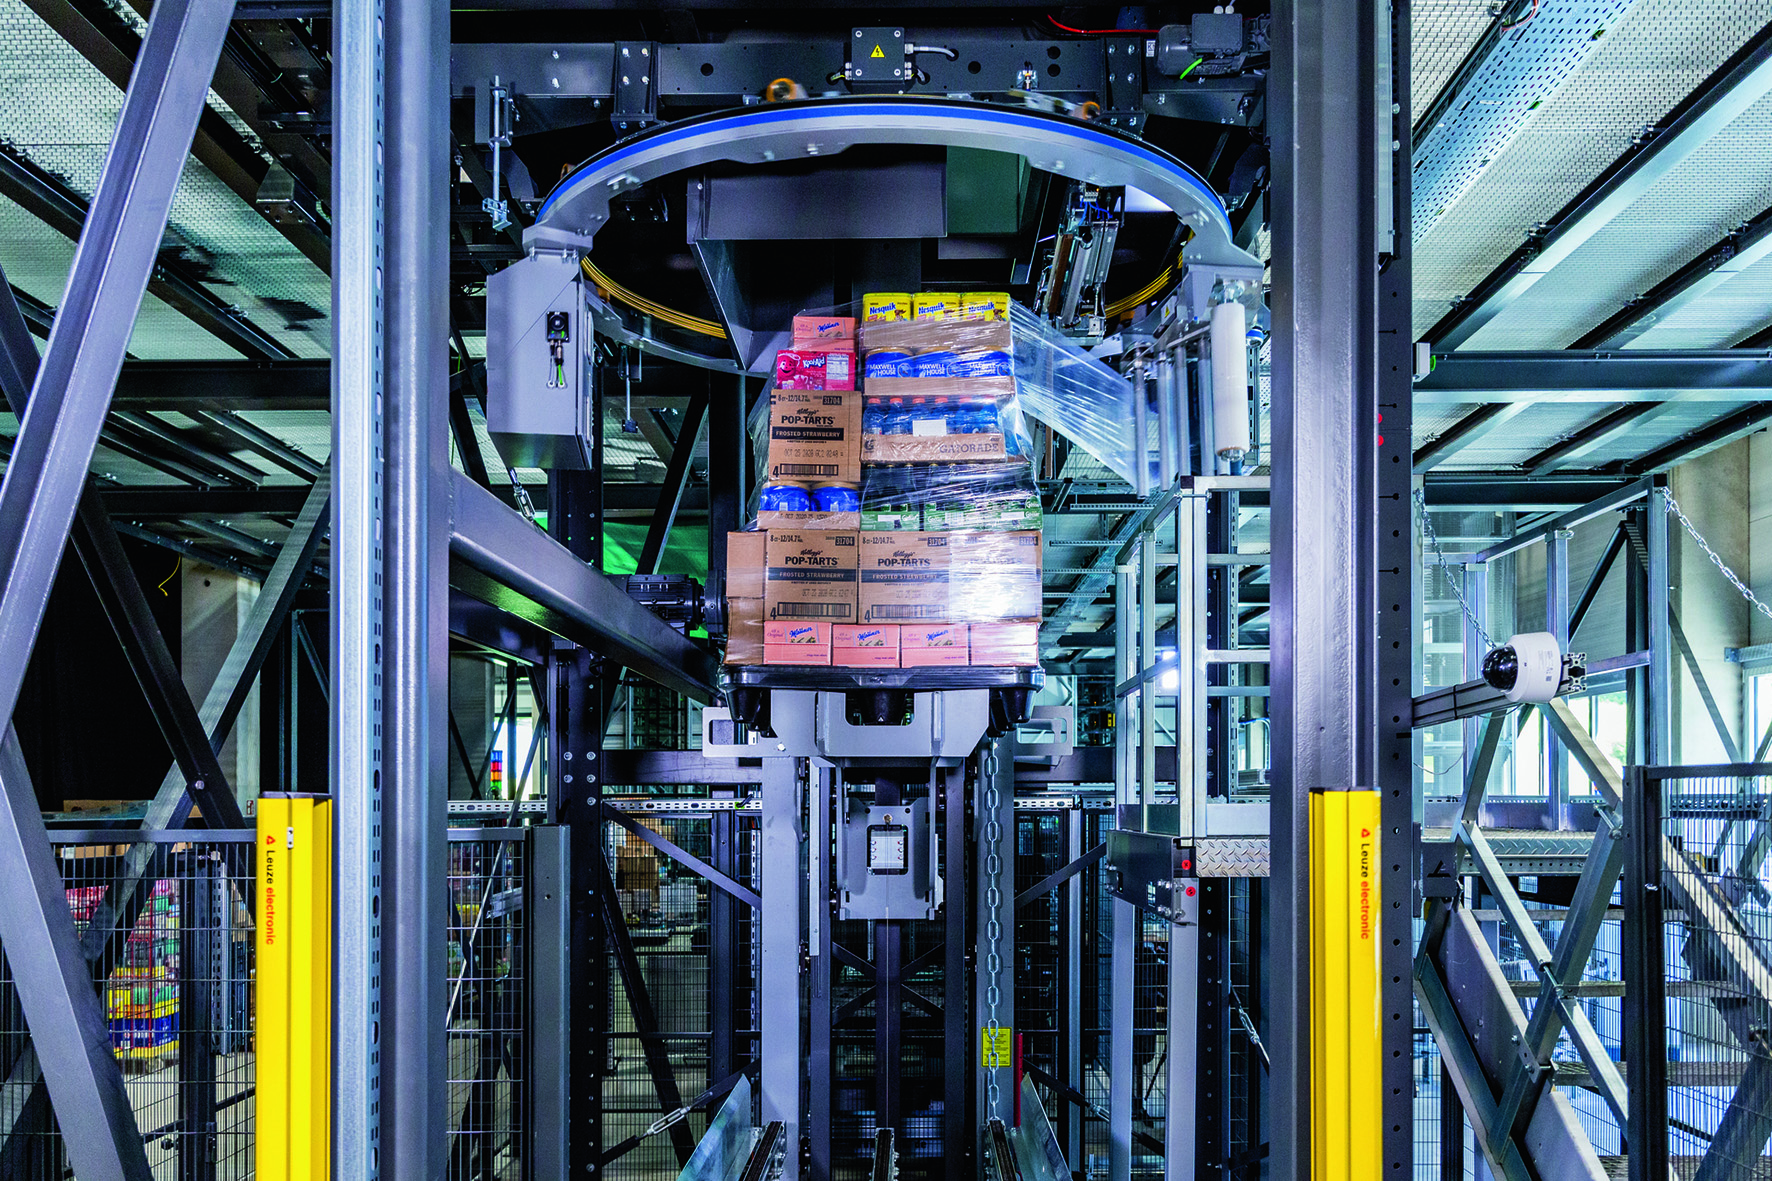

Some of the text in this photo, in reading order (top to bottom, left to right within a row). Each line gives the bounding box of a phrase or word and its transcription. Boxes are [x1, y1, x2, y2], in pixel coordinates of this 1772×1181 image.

[869, 302, 897, 315] Nesquik
[918, 301, 945, 315] Nesquik
[968, 301, 995, 314] Nesquik
[781, 416, 834, 424] POP-TARTS
[940, 443, 999, 453] GATORADE
[772, 465, 779, 477] 4
[836, 537, 853, 545] 31704
[785, 556, 838, 566] POP-TARTS
[878, 558, 930, 567] POP-TARTS
[770, 607, 776, 620] 4
[864, 610, 871, 622] 4
[266, 850, 276, 945] Leuze electronic
[1360, 843, 1370, 940] Leuze electronic
